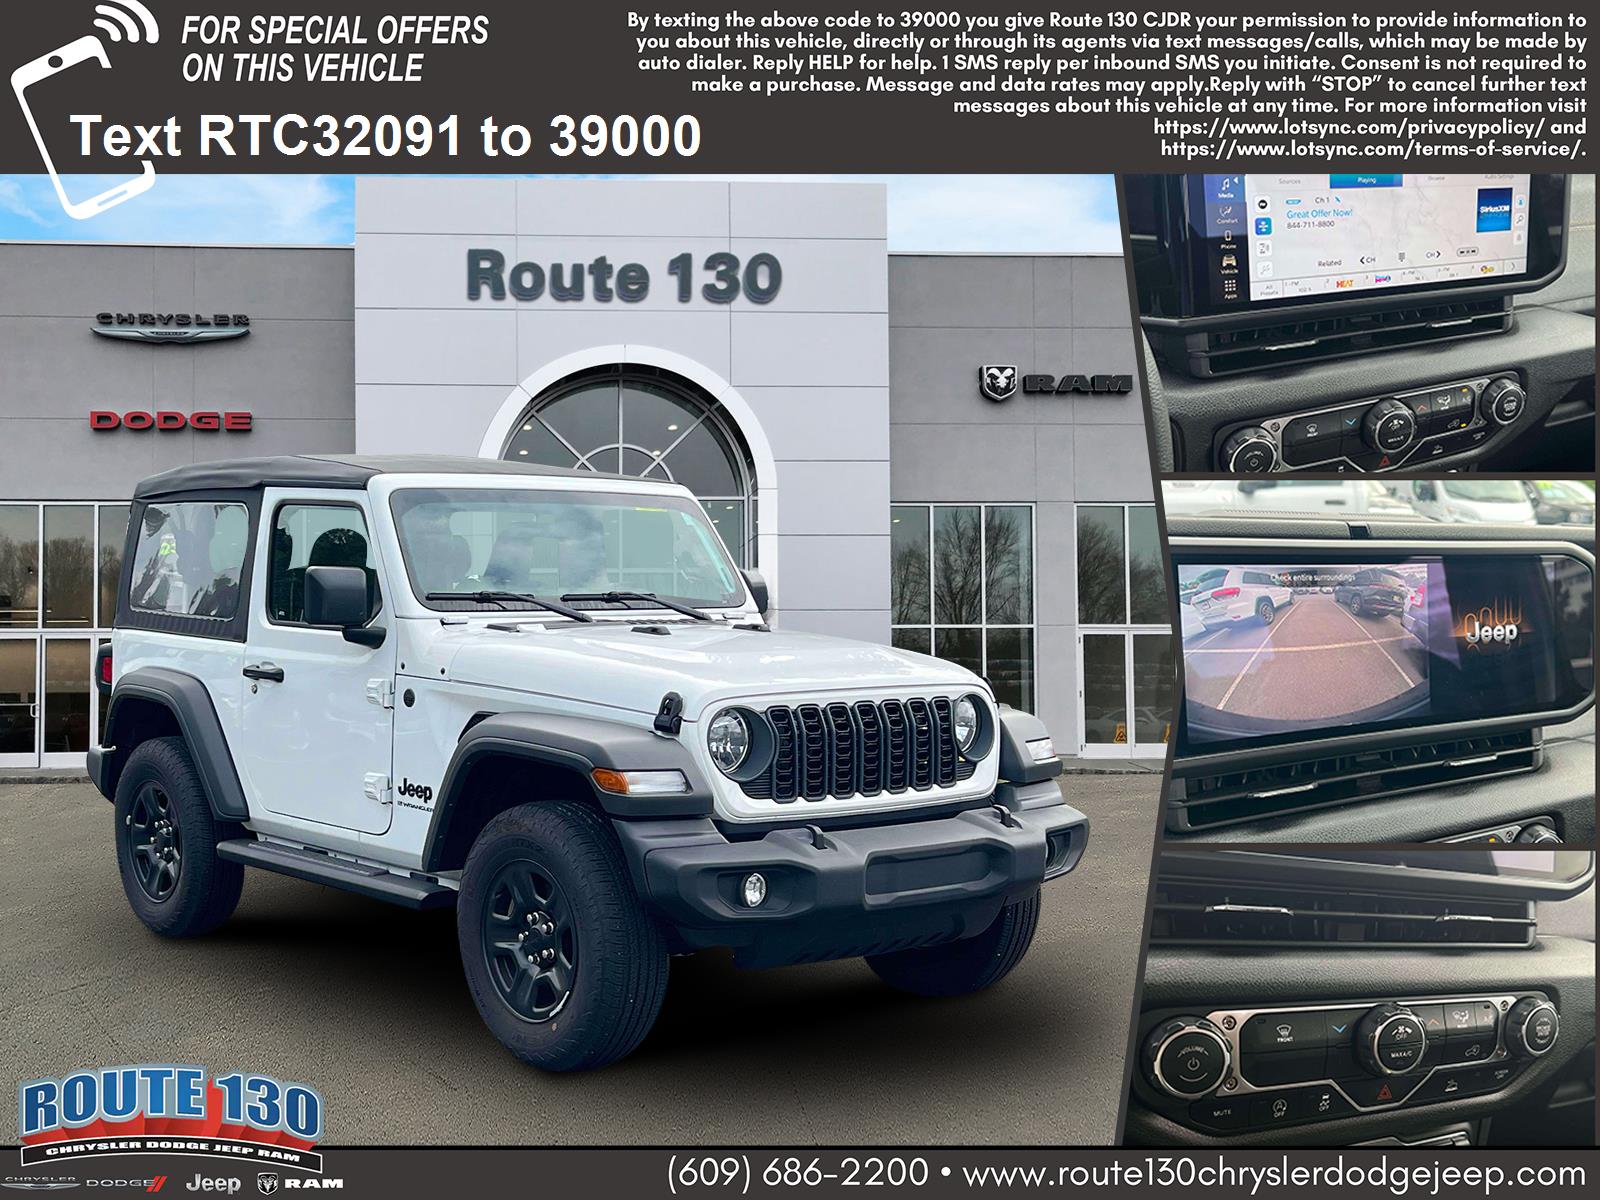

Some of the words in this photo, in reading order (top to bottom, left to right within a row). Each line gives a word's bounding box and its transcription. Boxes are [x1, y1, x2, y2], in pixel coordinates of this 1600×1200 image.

[1286, 209, 1309, 219] Great
[1311, 208, 1331, 218] Offer
[1333, 208, 1353, 217] Now!
[1479, 204, 1511, 213] SiriusXM
[1286, 220, 1335, 229] 844-711-8800
[1318, 258, 1342, 267] Related
[1365, 256, 1376, 264] CH
[467, 249, 650, 302] Route
[668, 252, 782, 305] 130
[96, 312, 250, 326] CHRYSLER
[1023, 374, 1133, 394] RAM
[90, 411, 253, 431] DODGE
[1270, 573, 1292, 582] Check
[1293, 573, 1312, 582] entire
[1313, 574, 1356, 583] surroundings
[1465, 620, 1519, 644] Jeep
[397, 777, 433, 804] Jeep
